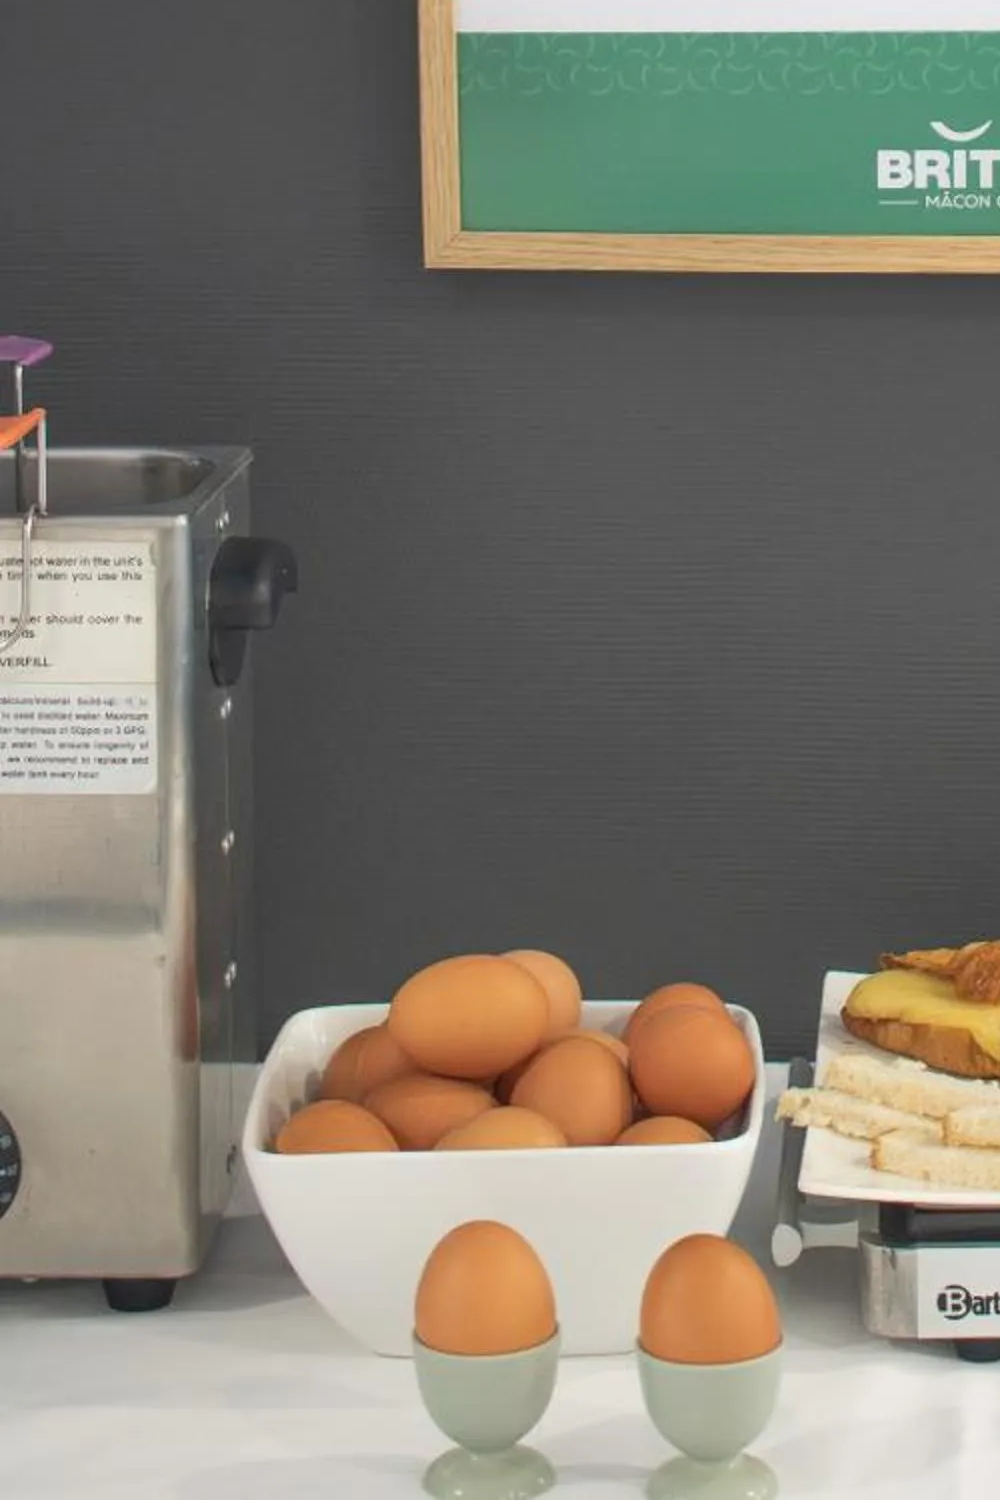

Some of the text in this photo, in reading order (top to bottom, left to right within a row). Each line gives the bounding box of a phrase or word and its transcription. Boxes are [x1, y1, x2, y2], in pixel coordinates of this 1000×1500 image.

[925, 191, 991, 209] MÂCON
[93, 556, 111, 567] the
[37, 571, 69, 581] when
[71, 572, 93, 583] you
[120, 571, 143, 581] this
[45, 613, 83, 625] should
[86, 614, 119, 625] cover
[123, 613, 143, 624] the
